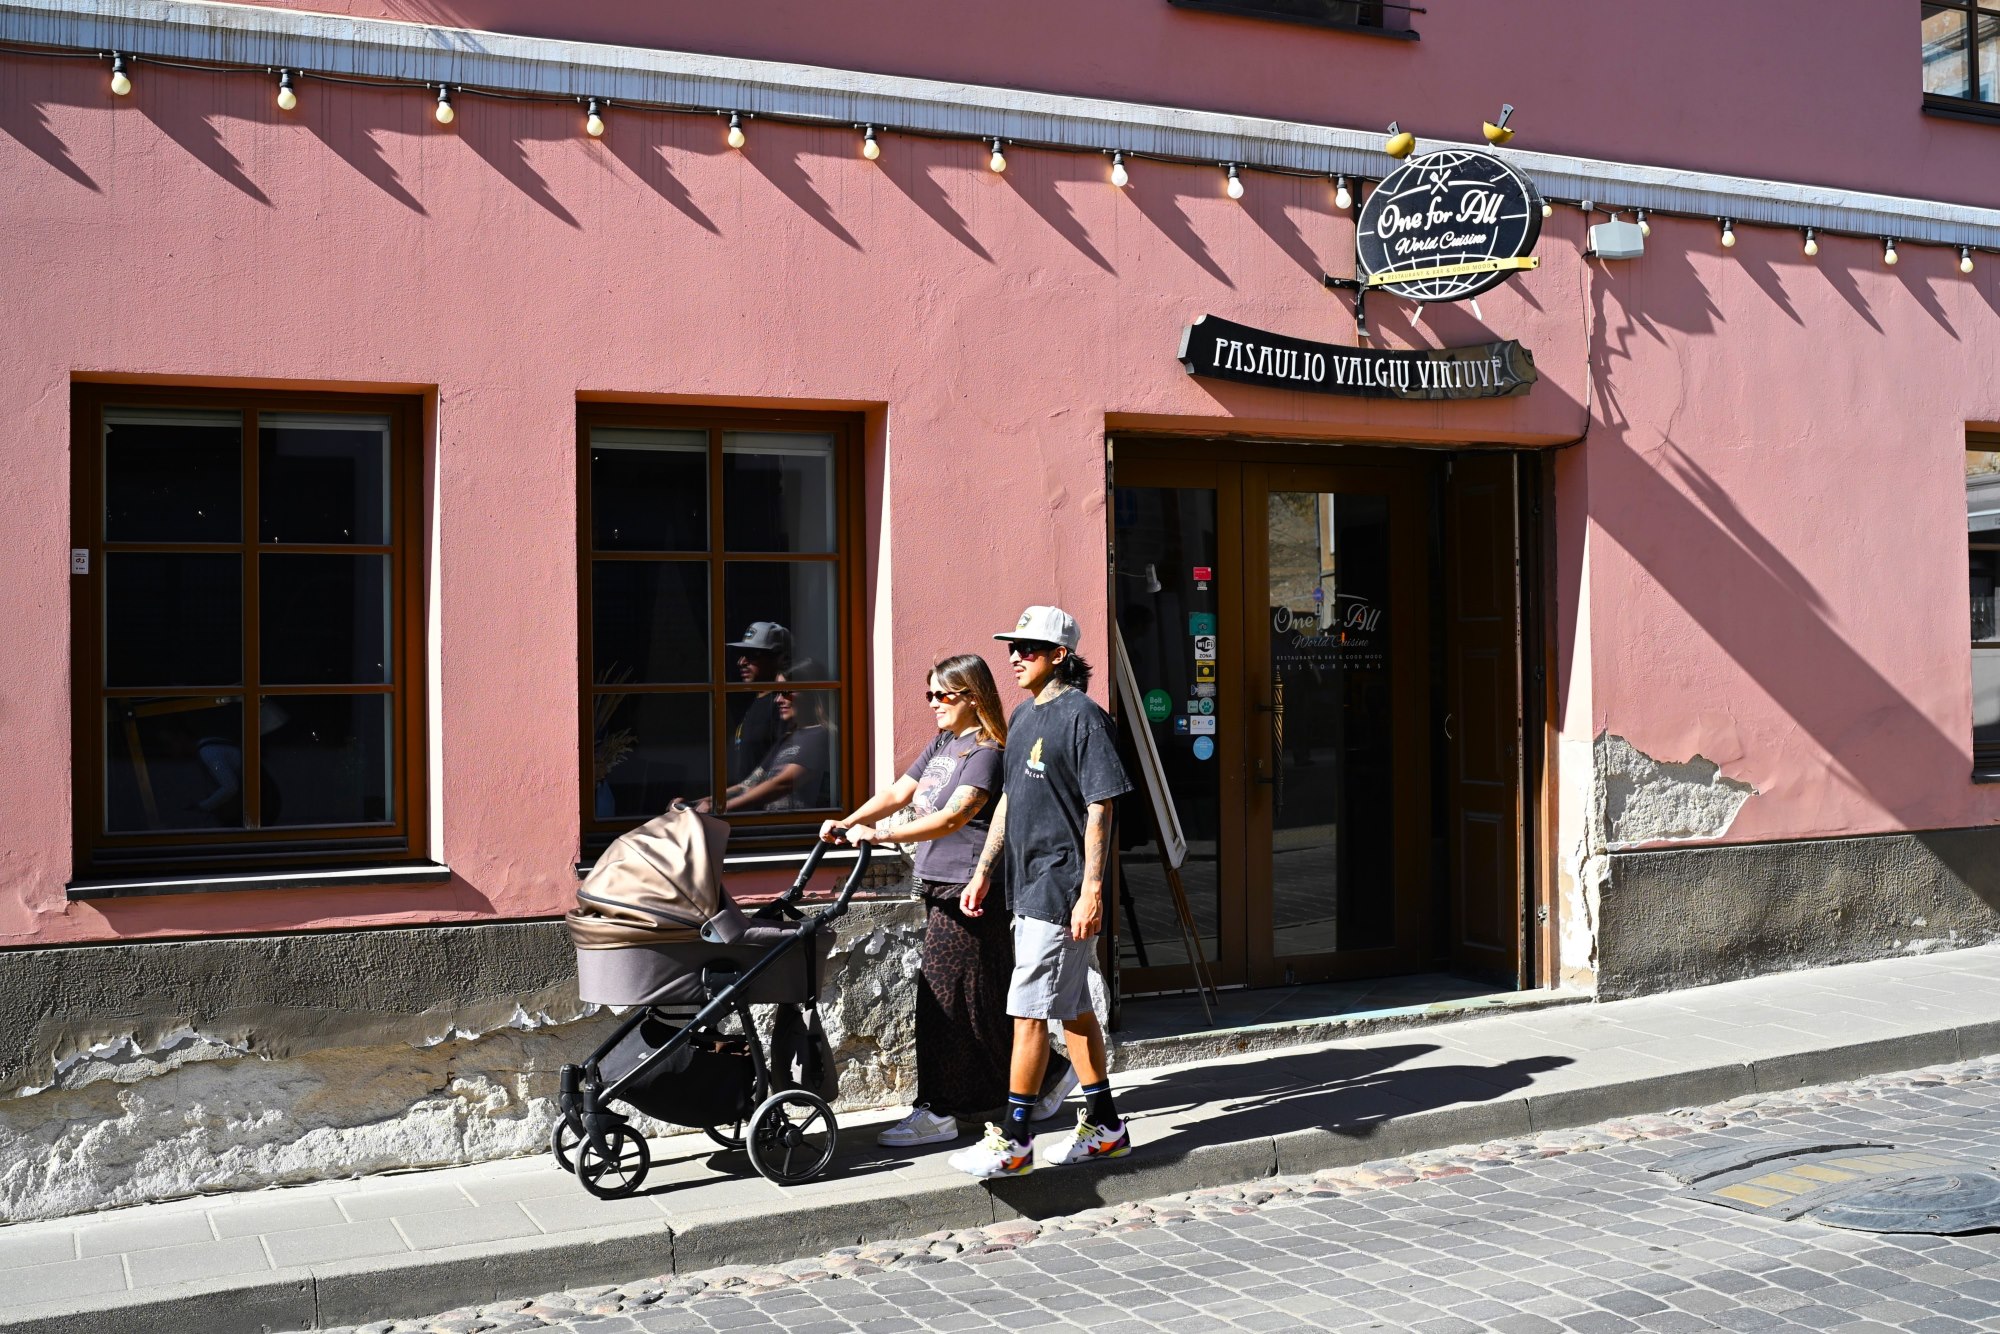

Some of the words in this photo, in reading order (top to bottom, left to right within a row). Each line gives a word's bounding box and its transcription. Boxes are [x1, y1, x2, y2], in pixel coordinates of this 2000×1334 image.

[1377, 204, 1422, 238] One
[1424, 196, 1453, 230] for
[1455, 189, 1505, 225] All
[1395, 236, 1439, 255] World
[1439, 231, 1487, 250] Cuisine
[1387, 271, 1424, 279] RESTAURANT
[1212, 337, 1326, 383] PASAULIO
[1333, 355, 1410, 393] VALGIŲ
[1412, 355, 1505, 389] VIRTUVĖ
[1273, 606, 1313, 633] One
[1343, 603, 1382, 632] All
[1292, 634, 1330, 650] World
[1331, 634, 1369, 648] Cuisine
[1149, 696, 1163, 704] Bolt
[1149, 704, 1166, 712] Food
